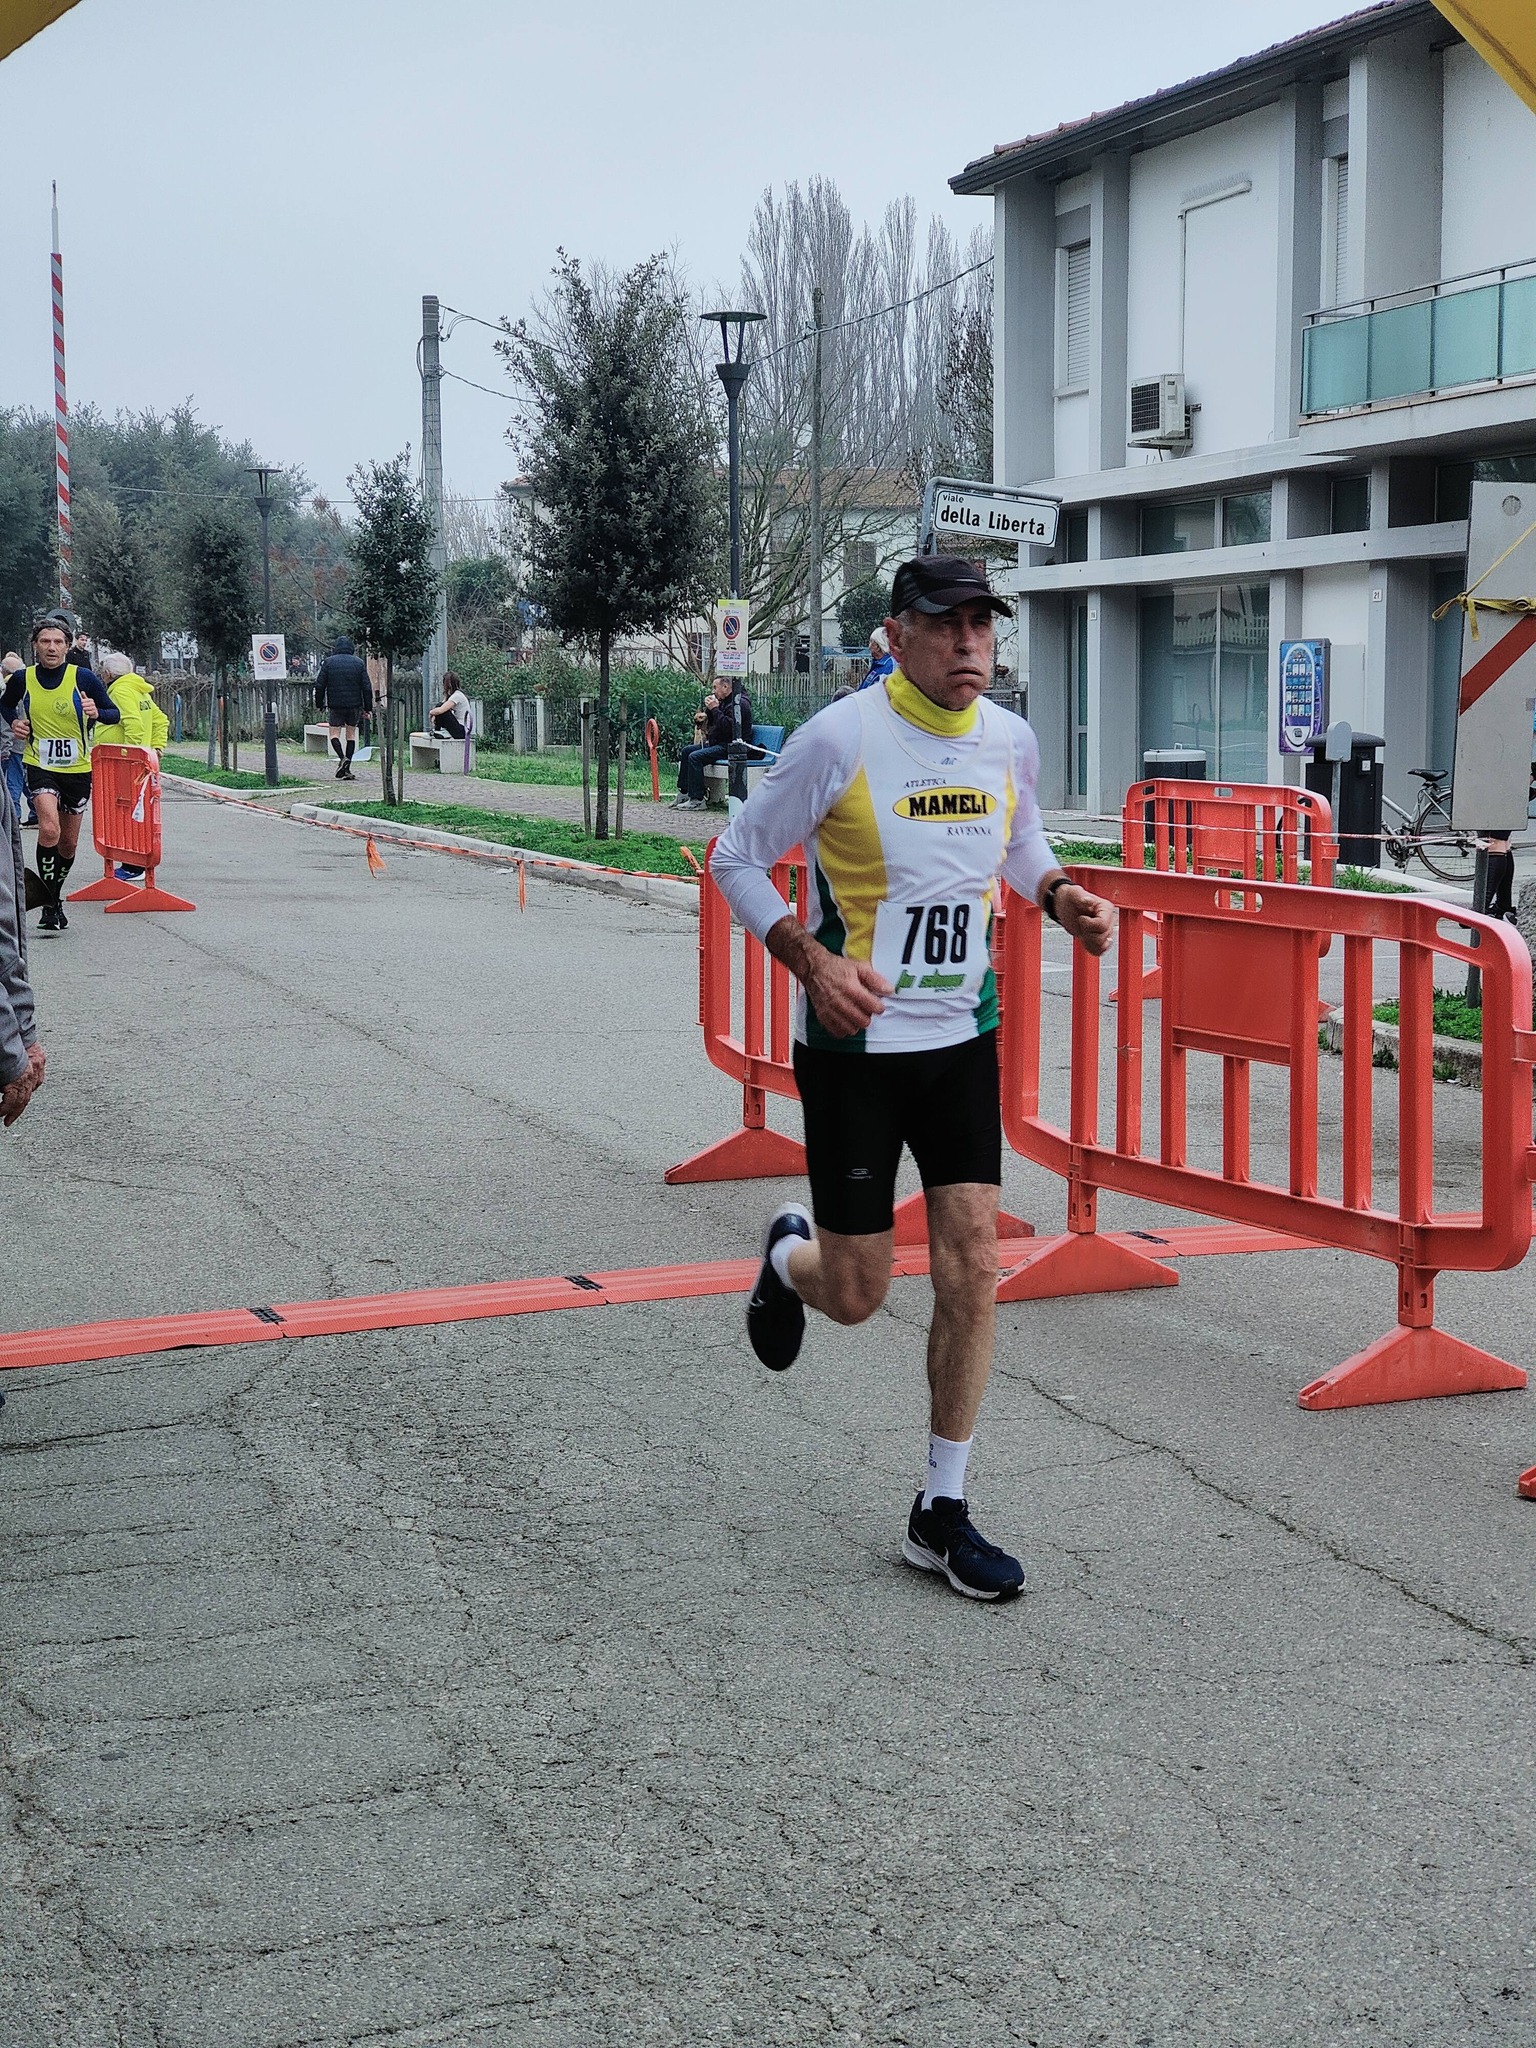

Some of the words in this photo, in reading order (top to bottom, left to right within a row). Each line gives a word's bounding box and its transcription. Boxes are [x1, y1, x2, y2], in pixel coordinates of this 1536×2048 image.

[943, 494, 964, 503] viale
[941, 505, 980, 527] della
[1373, 591, 1380, 599] 21
[47, 739, 72, 758] 785
[903, 777, 947, 789] ATLETICA
[908, 794, 988, 817] MAMELI
[901, 904, 970, 965] 768
